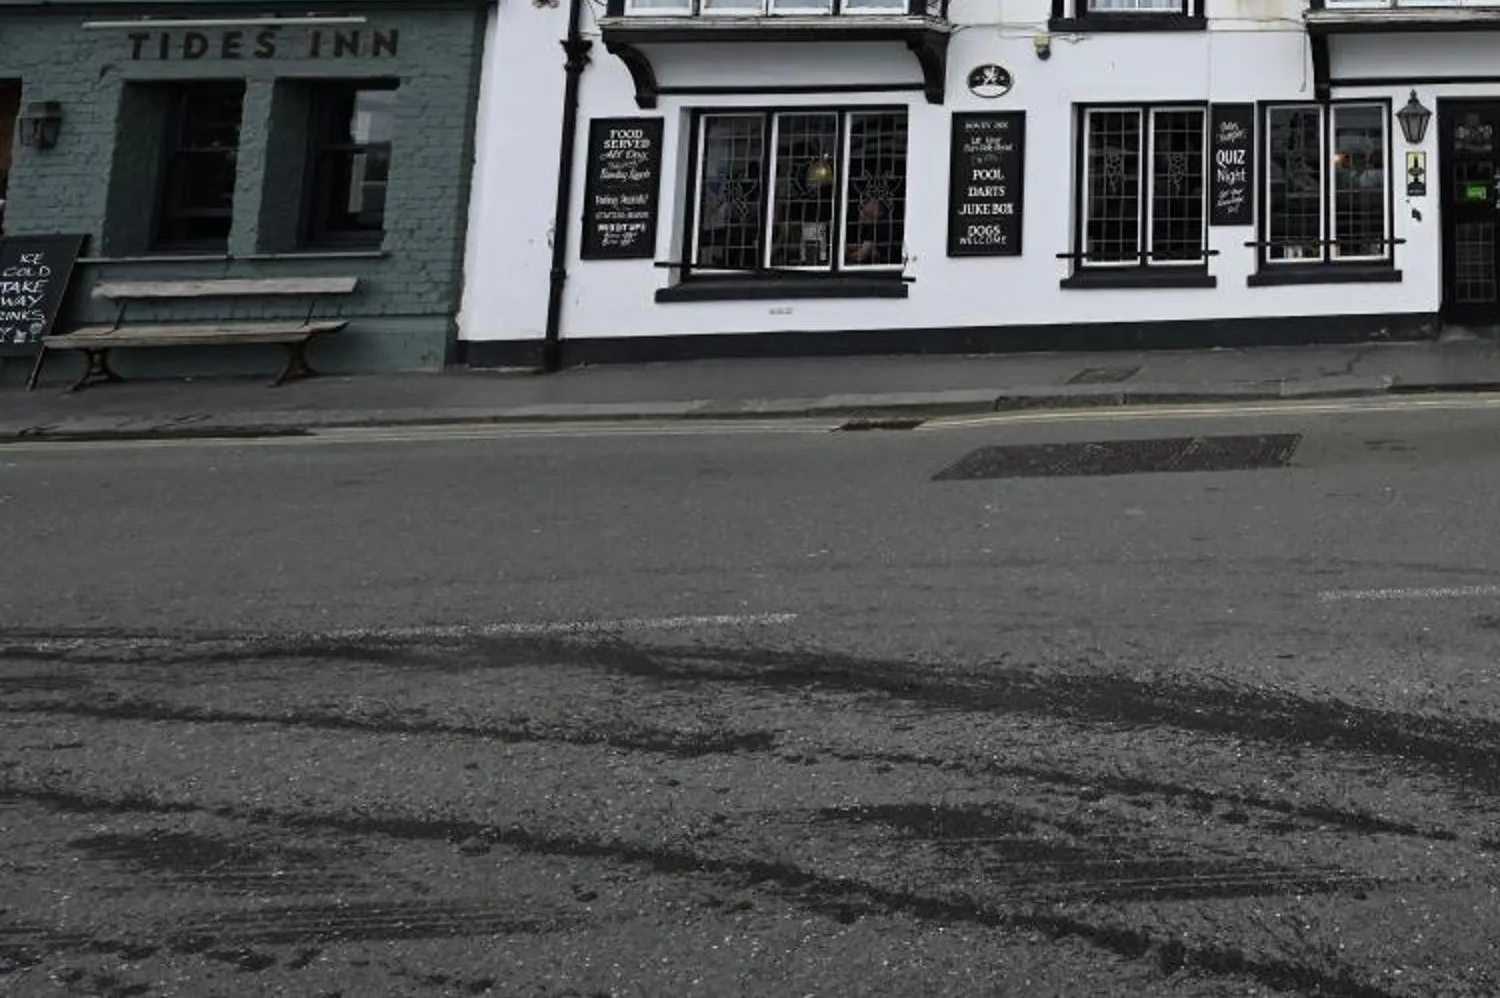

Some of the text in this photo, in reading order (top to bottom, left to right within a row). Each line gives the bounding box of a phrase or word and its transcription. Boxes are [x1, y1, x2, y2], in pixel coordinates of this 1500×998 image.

[128, 28, 400, 61] TIDES INN
[609, 129, 643, 139] FOOD
[603, 138, 651, 150] SERVED
[1216, 149, 1246, 169] QUIZ
[972, 169, 1005, 181] POOL
[1217, 168, 1247, 185] Night
[968, 185, 1006, 198] DARTS
[957, 203, 1014, 215] JUKE BOX
[968, 224, 1001, 237] DOGS
[959, 235, 1007, 245] WELCOME
[3, 266, 51, 277] COLD
[0, 279, 49, 294] TAKE
